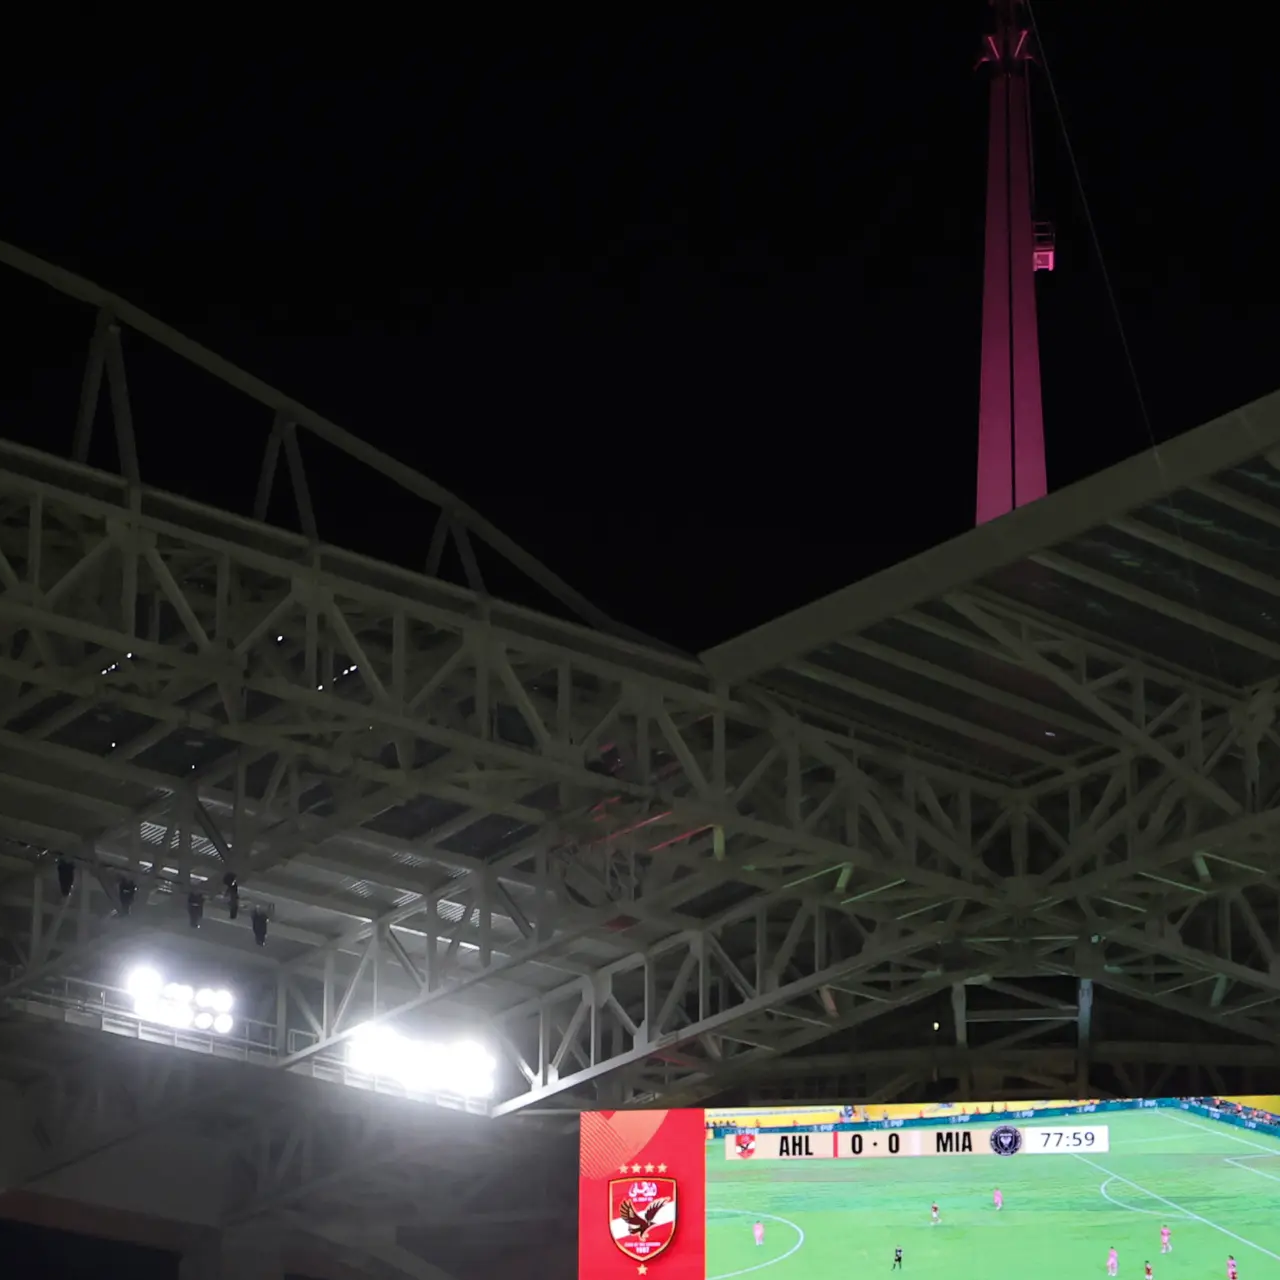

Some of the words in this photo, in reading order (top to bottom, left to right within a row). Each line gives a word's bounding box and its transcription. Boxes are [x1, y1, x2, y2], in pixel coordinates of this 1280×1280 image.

[778, 1134, 814, 1157] AHL
[850, 1133, 864, 1154] 0
[887, 1132, 900, 1153] 0
[935, 1131, 973, 1153] MIA
[1040, 1131, 1096, 1148] 77:59
